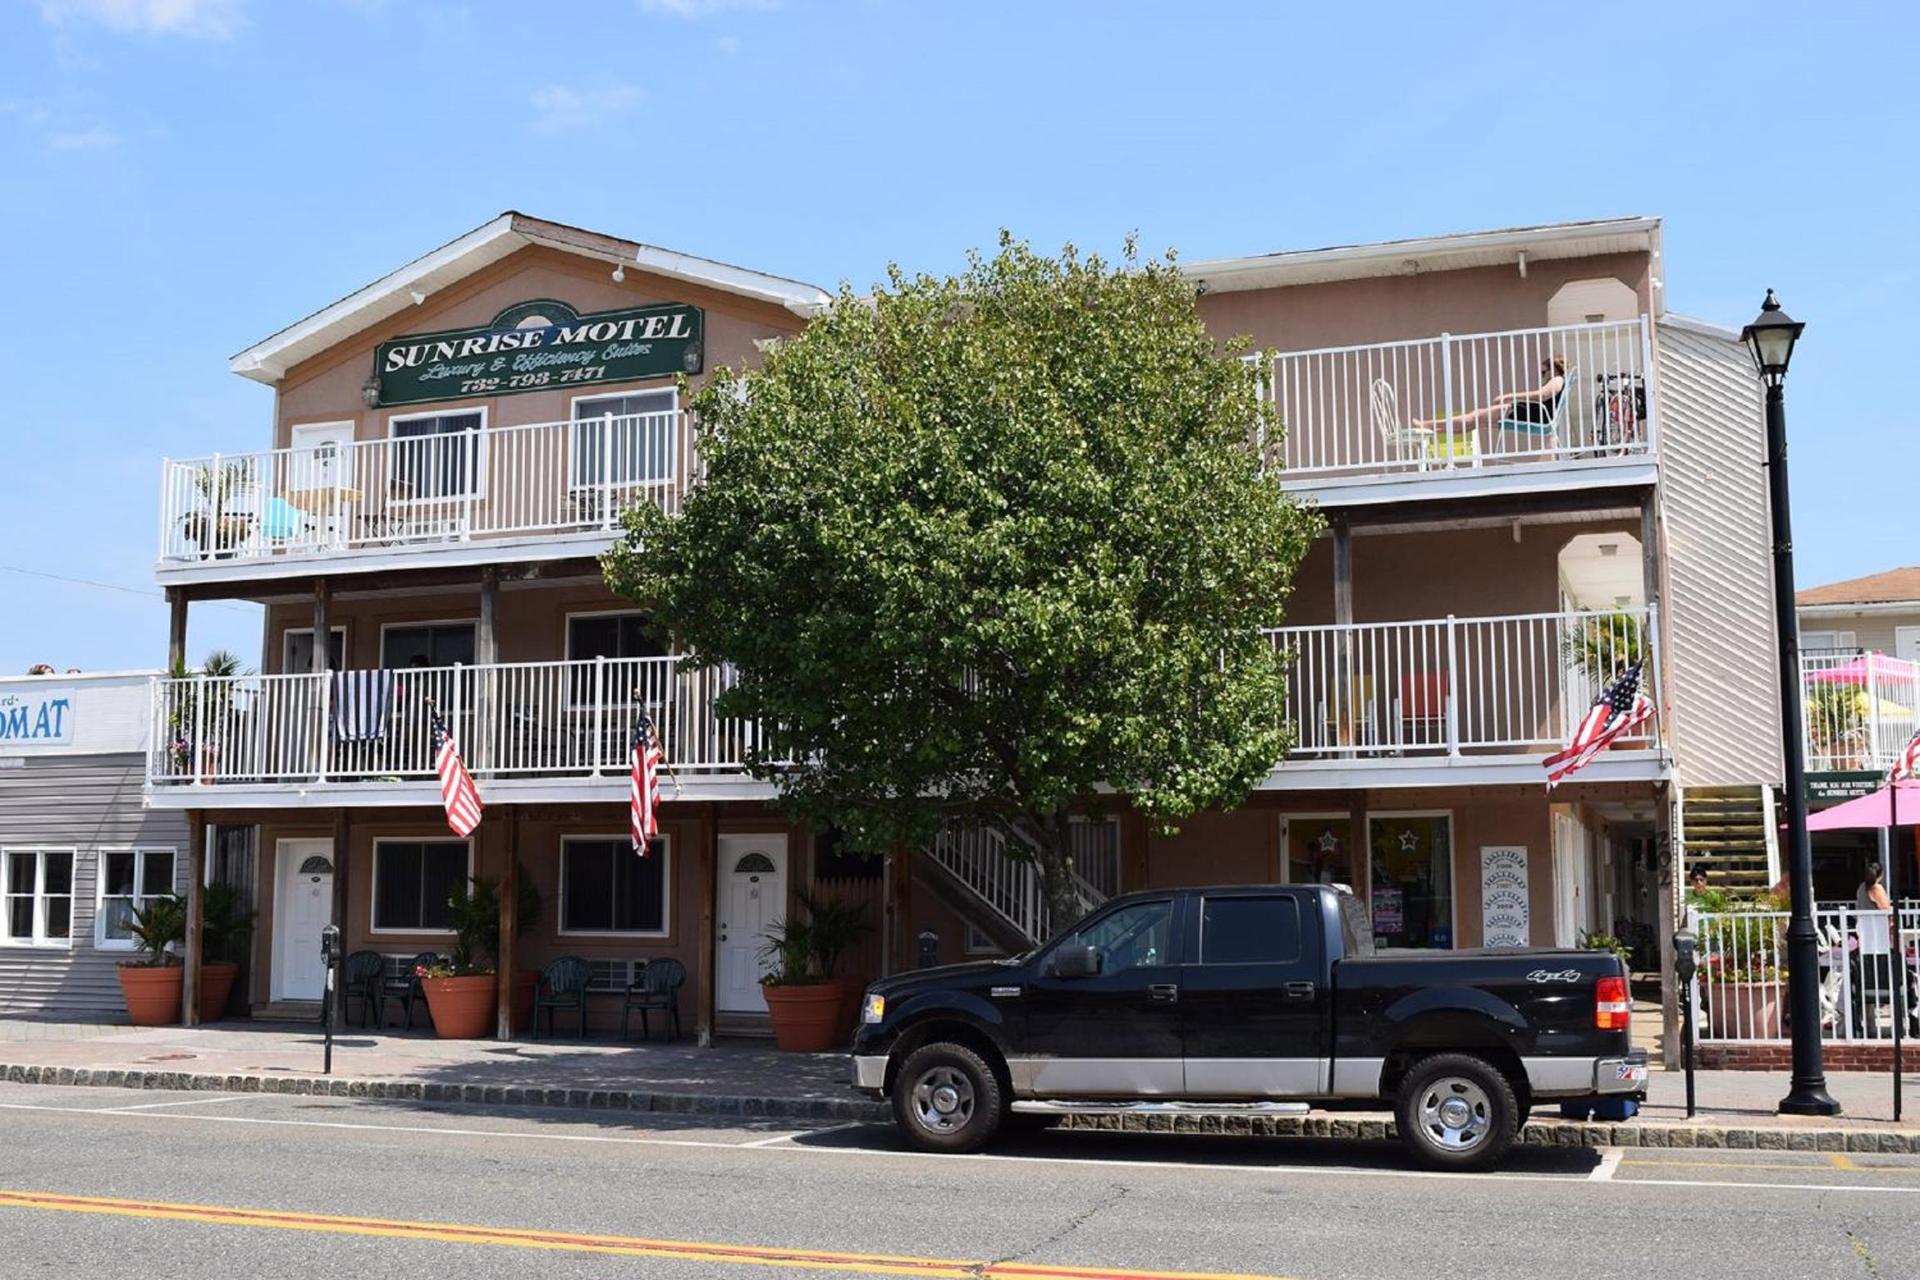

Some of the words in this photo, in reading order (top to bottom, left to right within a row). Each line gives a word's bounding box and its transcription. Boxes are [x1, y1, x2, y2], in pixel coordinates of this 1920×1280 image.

[385, 329, 545, 373] SUNRISE
[551, 313, 691, 346] MOTEL
[419, 362, 486, 381] Luxury
[512, 350, 597, 372] Efficiency
[601, 342, 653, 361] Suites
